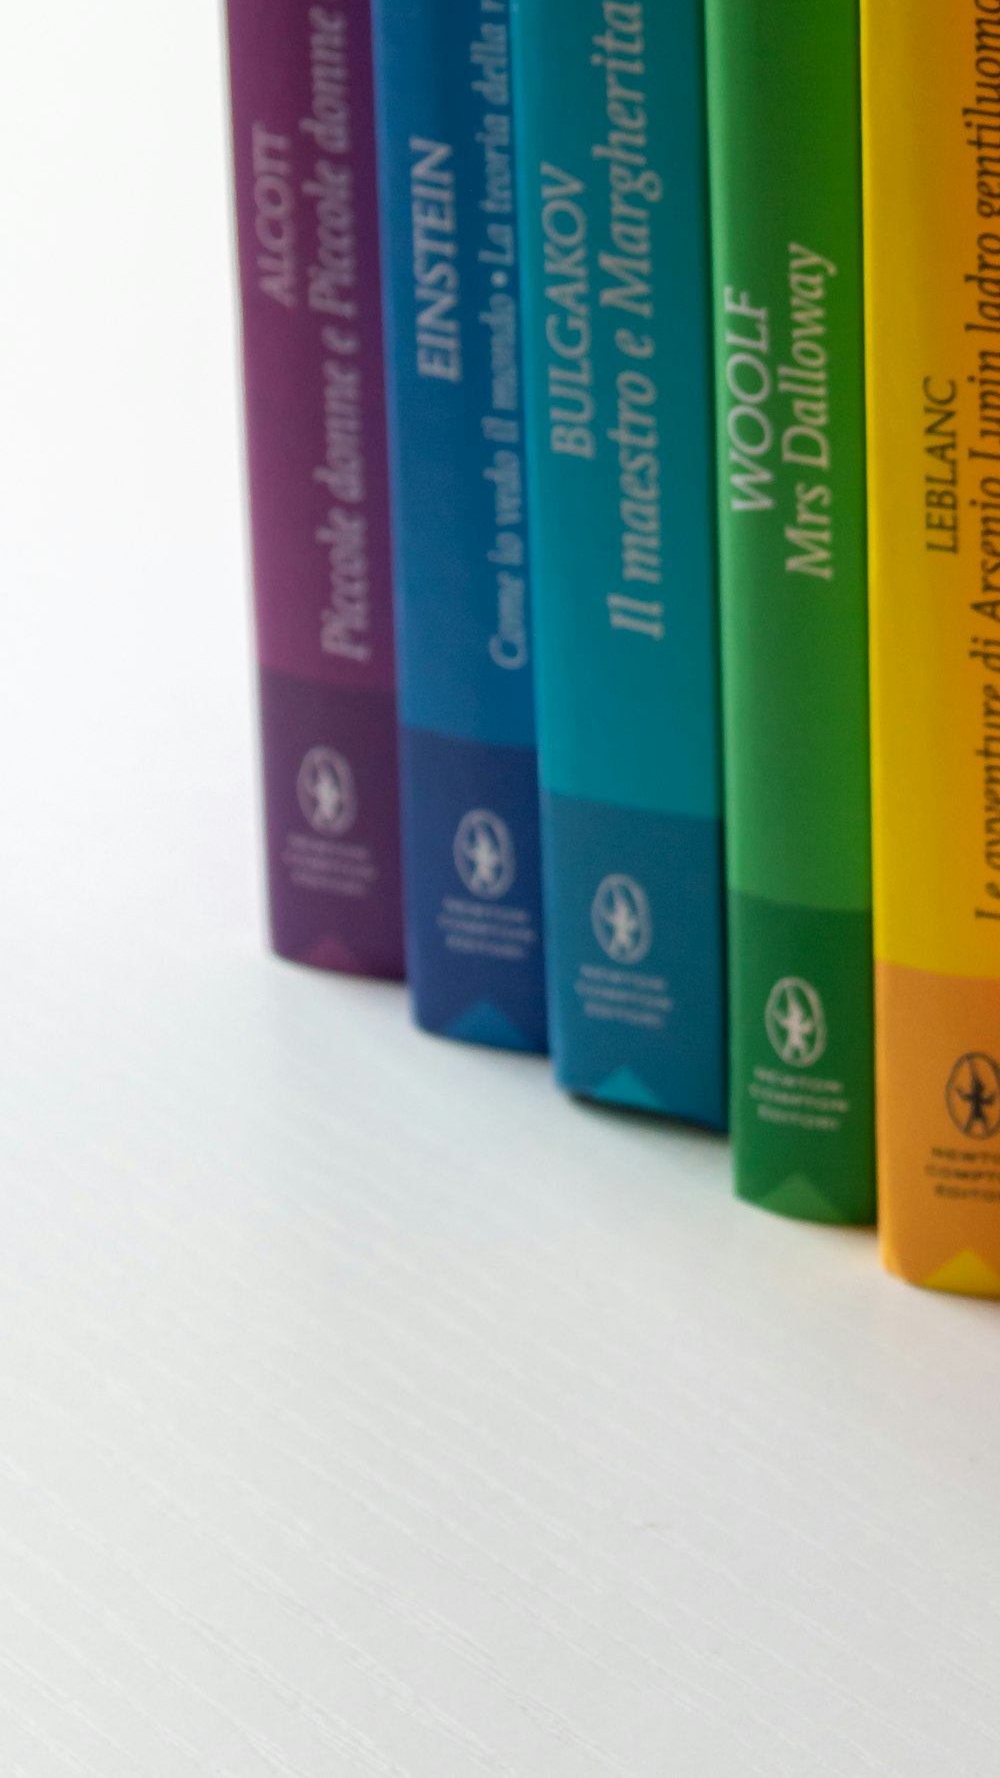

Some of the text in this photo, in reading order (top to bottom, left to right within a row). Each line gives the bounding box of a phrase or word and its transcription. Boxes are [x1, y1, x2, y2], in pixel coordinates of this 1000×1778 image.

[300, 5, 349, 155] donne
[470, 23, 509, 106] della
[252, 122, 296, 309] ALCOTT
[304, 159, 357, 320] Piccole
[408, 134, 462, 383] EINSTEIN
[478, 223, 515, 266] La
[322, 327, 358, 357] e
[540, 162, 597, 460] BULGAKOV
[615, 328, 656, 359] e
[312, 359, 364, 504] donne
[607, 370, 662, 584] maestro
[724, 285, 775, 512] WOOLF
[777, 241, 838, 580] Mrs Dalloway
[922, 375, 959, 554] LEBLANC
[316, 508, 371, 663] Piccole
[606, 592, 666, 641] Il
